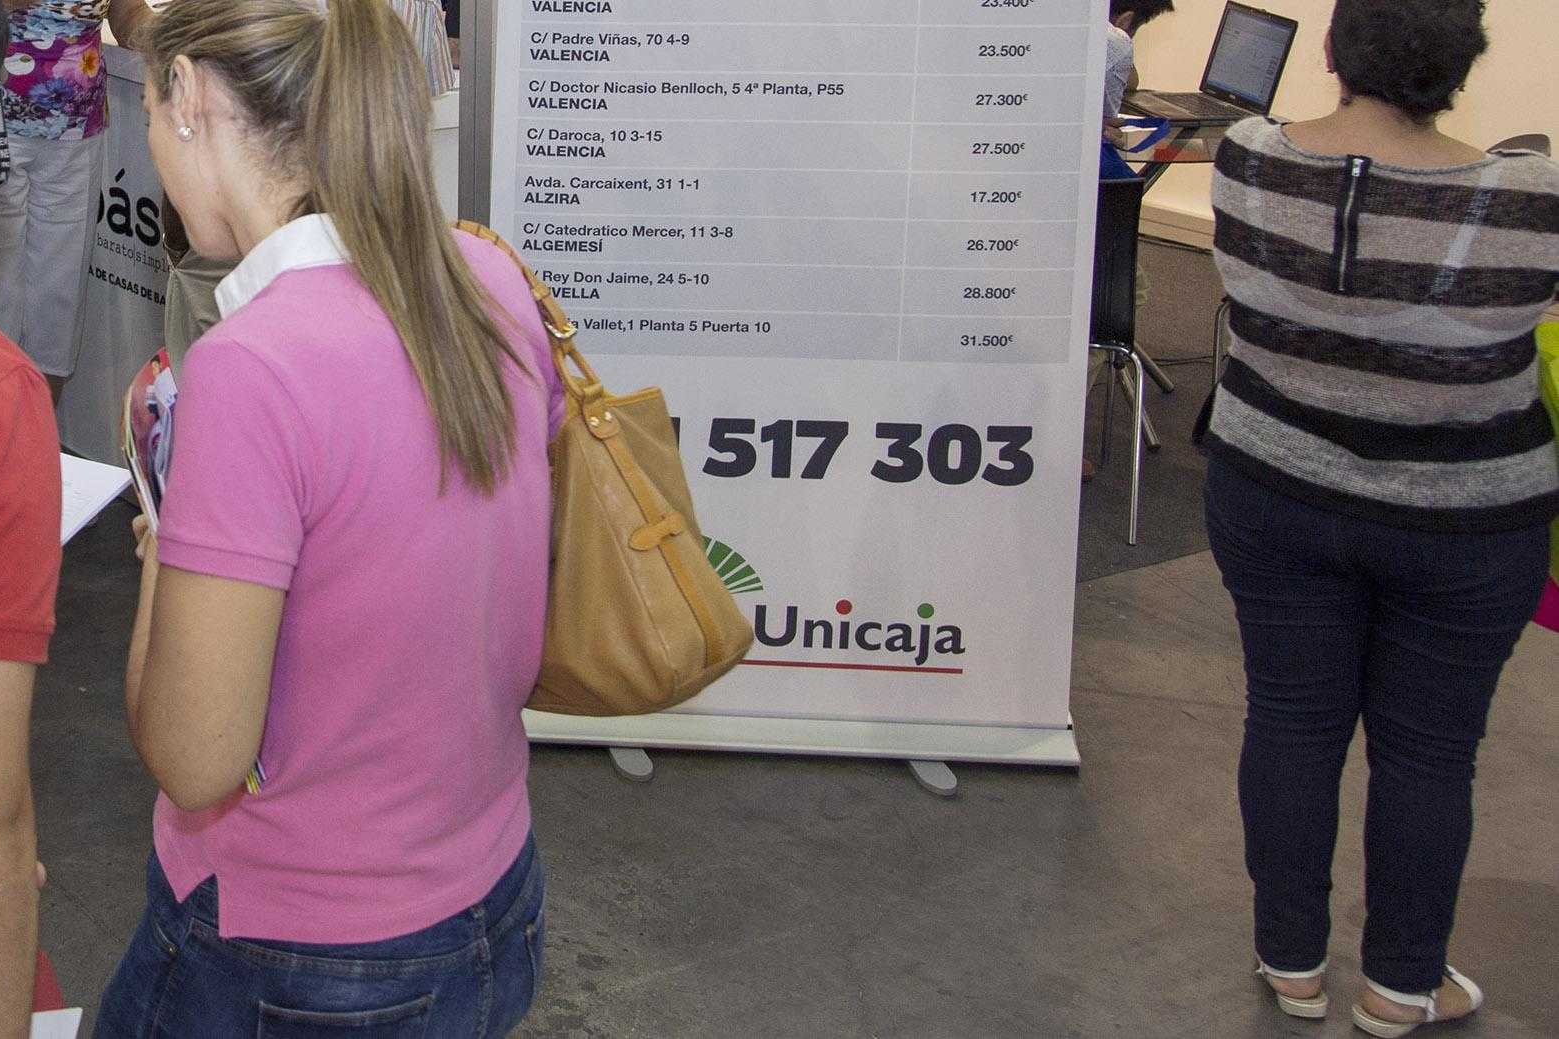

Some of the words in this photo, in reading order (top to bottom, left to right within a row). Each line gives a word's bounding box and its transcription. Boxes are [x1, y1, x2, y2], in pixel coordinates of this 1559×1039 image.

[532, 1, 612, 13] VALENCIA
[531, 32, 548, 44] C/
[552, 33, 594, 45] Padre
[598, 33, 642, 48] Viñas,
[646, 34, 662, 45] 70
[667, 34, 690, 45] 4-9
[530, 49, 610, 62] VALENCIA
[978, 44, 1031, 57] 23.500€
[529, 81, 546, 93] C/
[550, 81, 599, 94] Doctor
[604, 82, 658, 94] Nicasio
[661, 82, 727, 97] Benlloch,
[732, 83, 741, 94] 5
[744, 83, 759, 94] 4ª
[763, 83, 812, 98] Planta,
[817, 84, 844, 95] P55
[528, 97, 608, 110] VALENCIA
[975, 94, 1029, 106] 27.300€
[527, 128, 545, 140] C/
[548, 128, 605, 143] Daroca,
[610, 130, 626, 142] 10
[630, 130, 663, 142] 3-15
[526, 145, 606, 158] VALENCIA
[972, 142, 1026, 155] 27.500€
[524, 176, 565, 189] Avda.
[569, 176, 652, 191] Carcaixent,
[656, 178, 673, 190] 31
[678, 178, 700, 190] 1-1
[524, 193, 580, 206] ALZIRA
[970, 191, 1022, 203] 17.200€
[523, 223, 540, 235] C/
[544, 223, 628, 237] Catedratico
[632, 225, 685, 239] Mercer,
[690, 226, 706, 237] 11
[710, 226, 734, 238] 3-8
[522, 239, 603, 252] ALGEMESÍ
[967, 239, 1019, 251] 26.700€
[95, 268, 108, 282] DE
[108, 272, 139, 295] CASAS
[140, 285, 153, 301] DE
[542, 271, 569, 284] Rey
[574, 272, 602, 284] Don
[606, 272, 653, 286] Jaime,
[657, 273, 674, 285] 24
[678, 273, 710, 285] 5-10
[549, 287, 600, 300] VELLA
[963, 287, 1016, 299] 28.800€
[640, 320, 685, 332] Planta
[689, 320, 698, 332] 5
[702, 320, 749, 333] Puerta
[754, 321, 771, 333] 10
[960, 335, 1014, 347] 31.500€
[702, 417, 849, 479] 517
[871, 422, 1034, 486] 303
[754, 599, 966, 665] Unicaja
